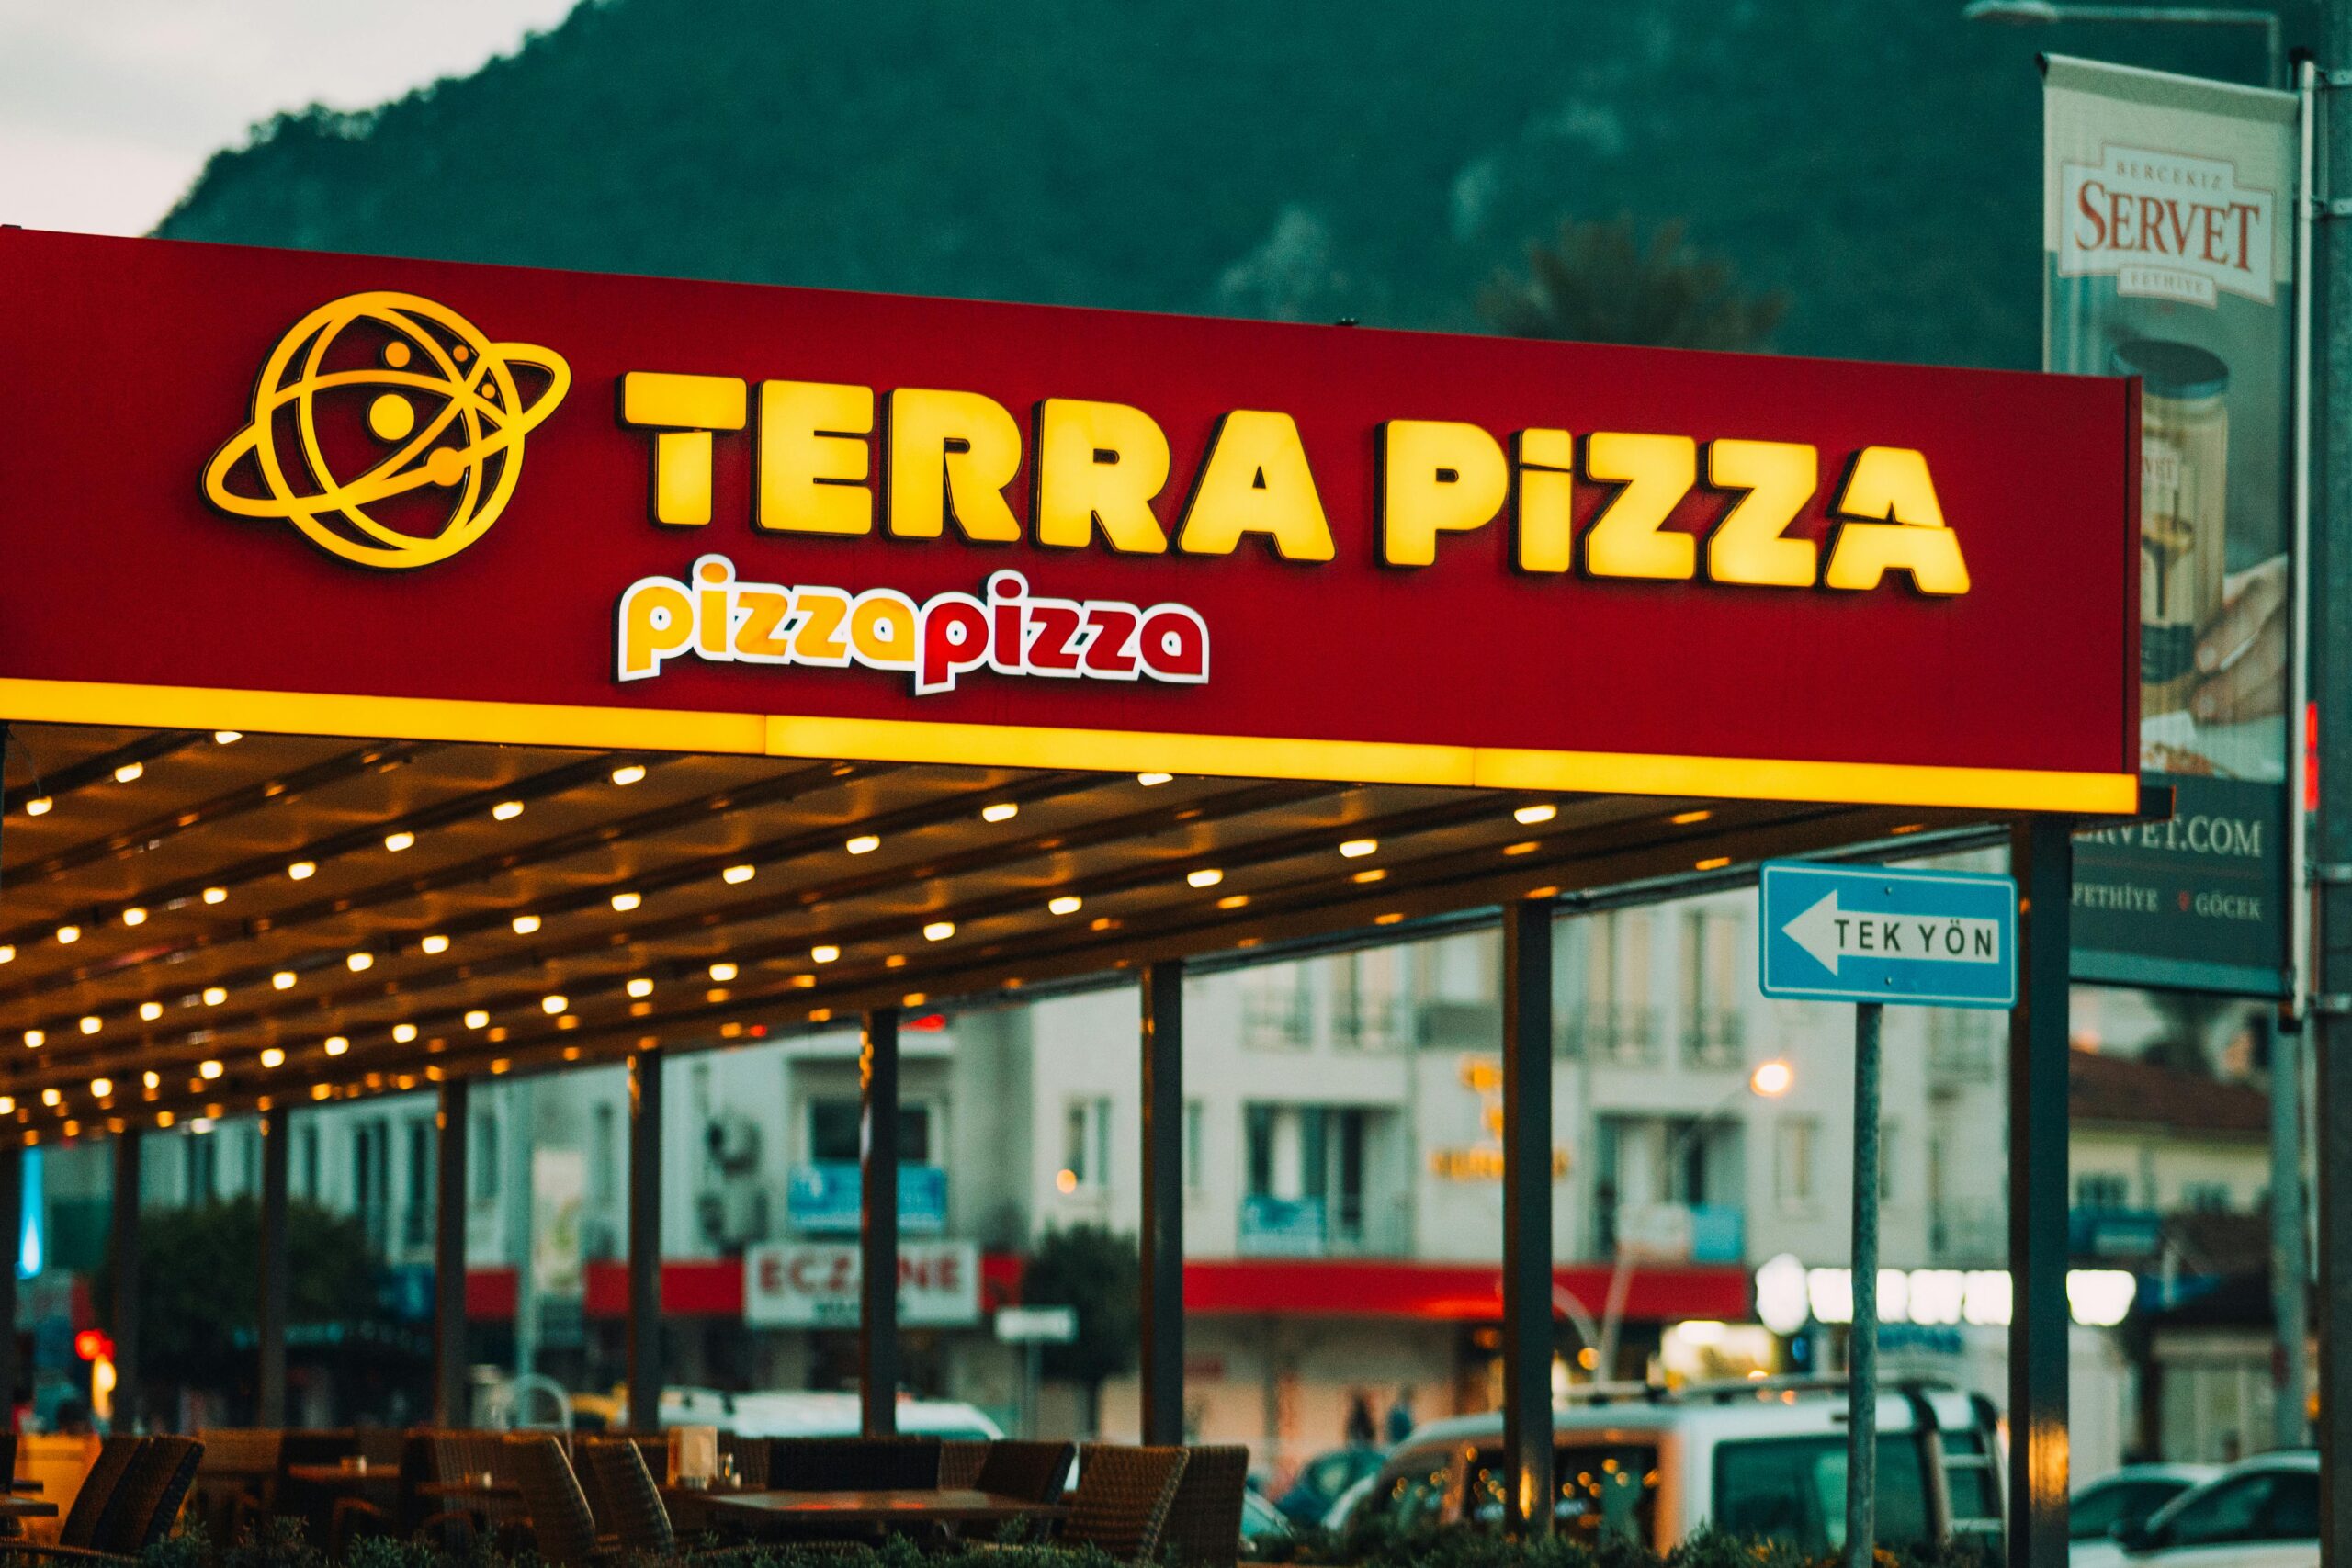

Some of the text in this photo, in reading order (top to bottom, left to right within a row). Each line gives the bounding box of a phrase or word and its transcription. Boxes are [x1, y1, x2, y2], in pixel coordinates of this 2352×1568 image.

[2075, 179, 2260, 273] SERVET
[624, 371, 1336, 562] TERRA
[1834, 919, 1991, 957] TEK YÖN
[759, 1255, 959, 1293] ECZNE
